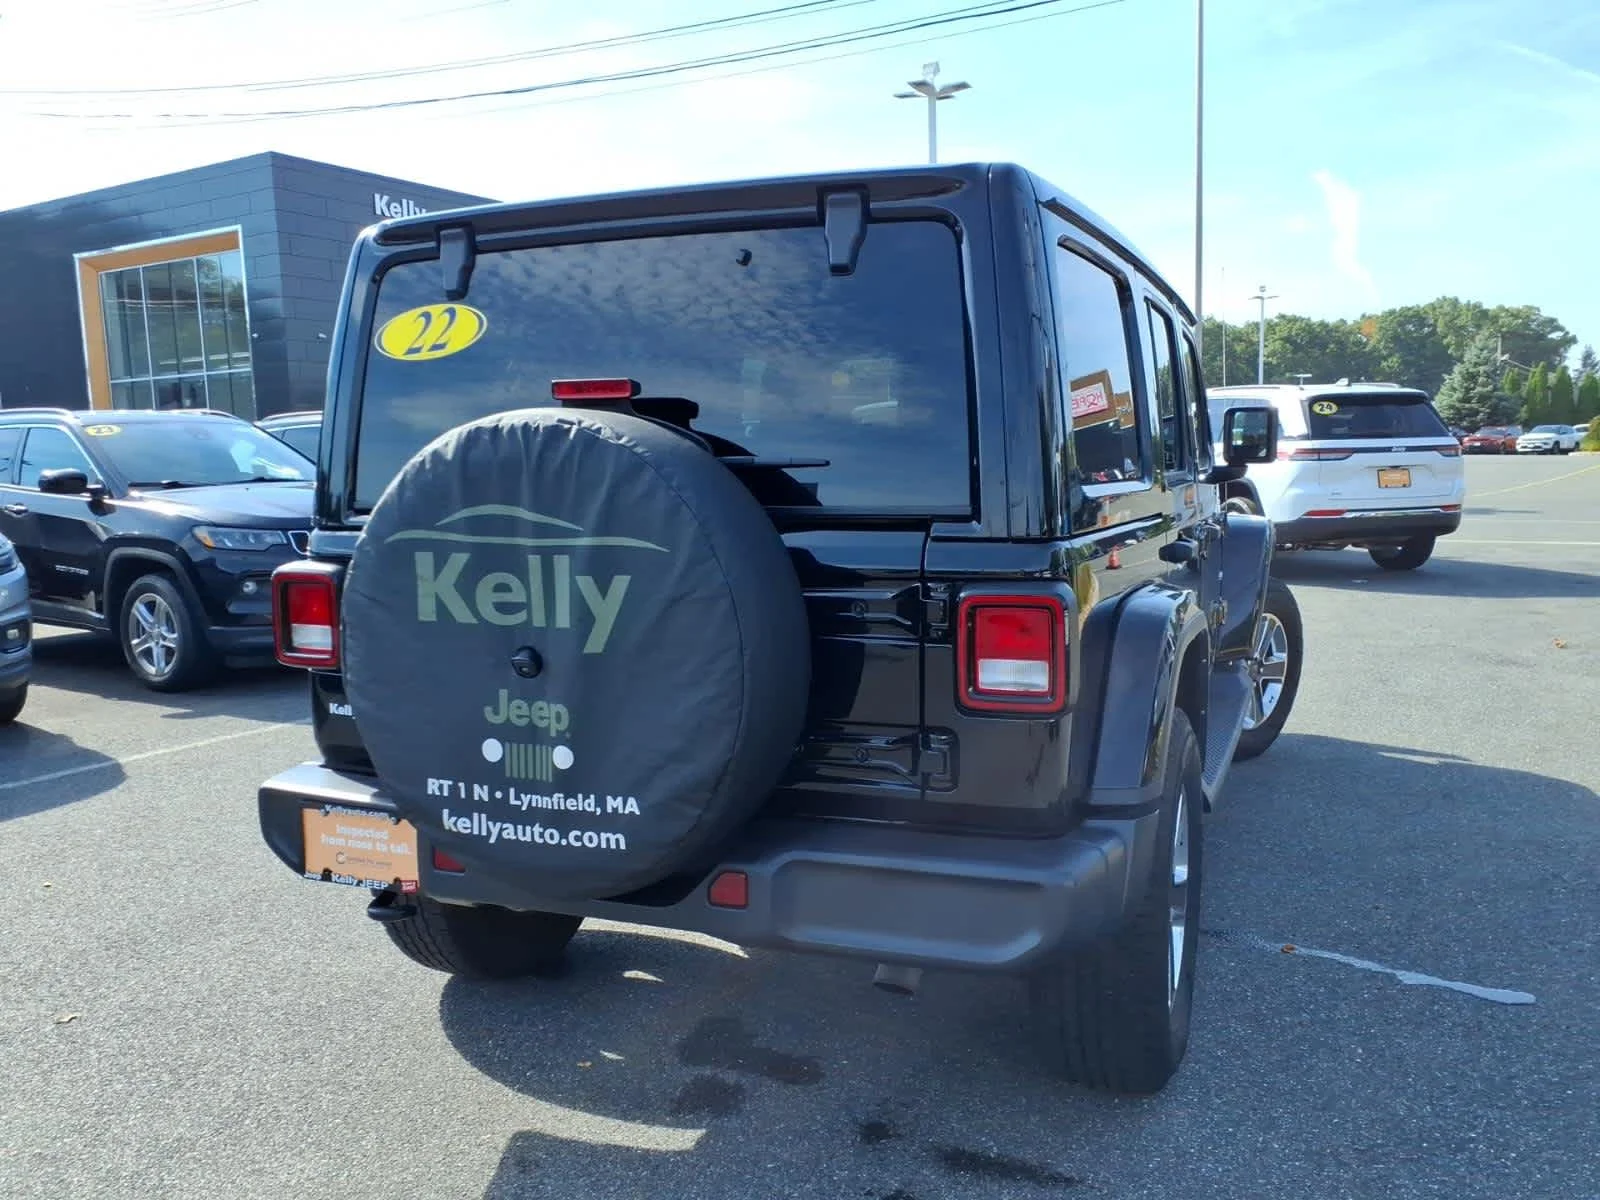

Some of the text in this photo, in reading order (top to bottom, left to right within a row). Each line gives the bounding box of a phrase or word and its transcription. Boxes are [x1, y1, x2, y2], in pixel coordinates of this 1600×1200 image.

[403, 306, 457, 356] 22
[415, 551, 632, 654] Kelly
[329, 702, 352, 716] Kell
[484, 689, 570, 737] Jeep
[427, 778, 641, 815] RT 1 N Lynnfield, MA
[441, 808, 627, 850] kellyauto.com
